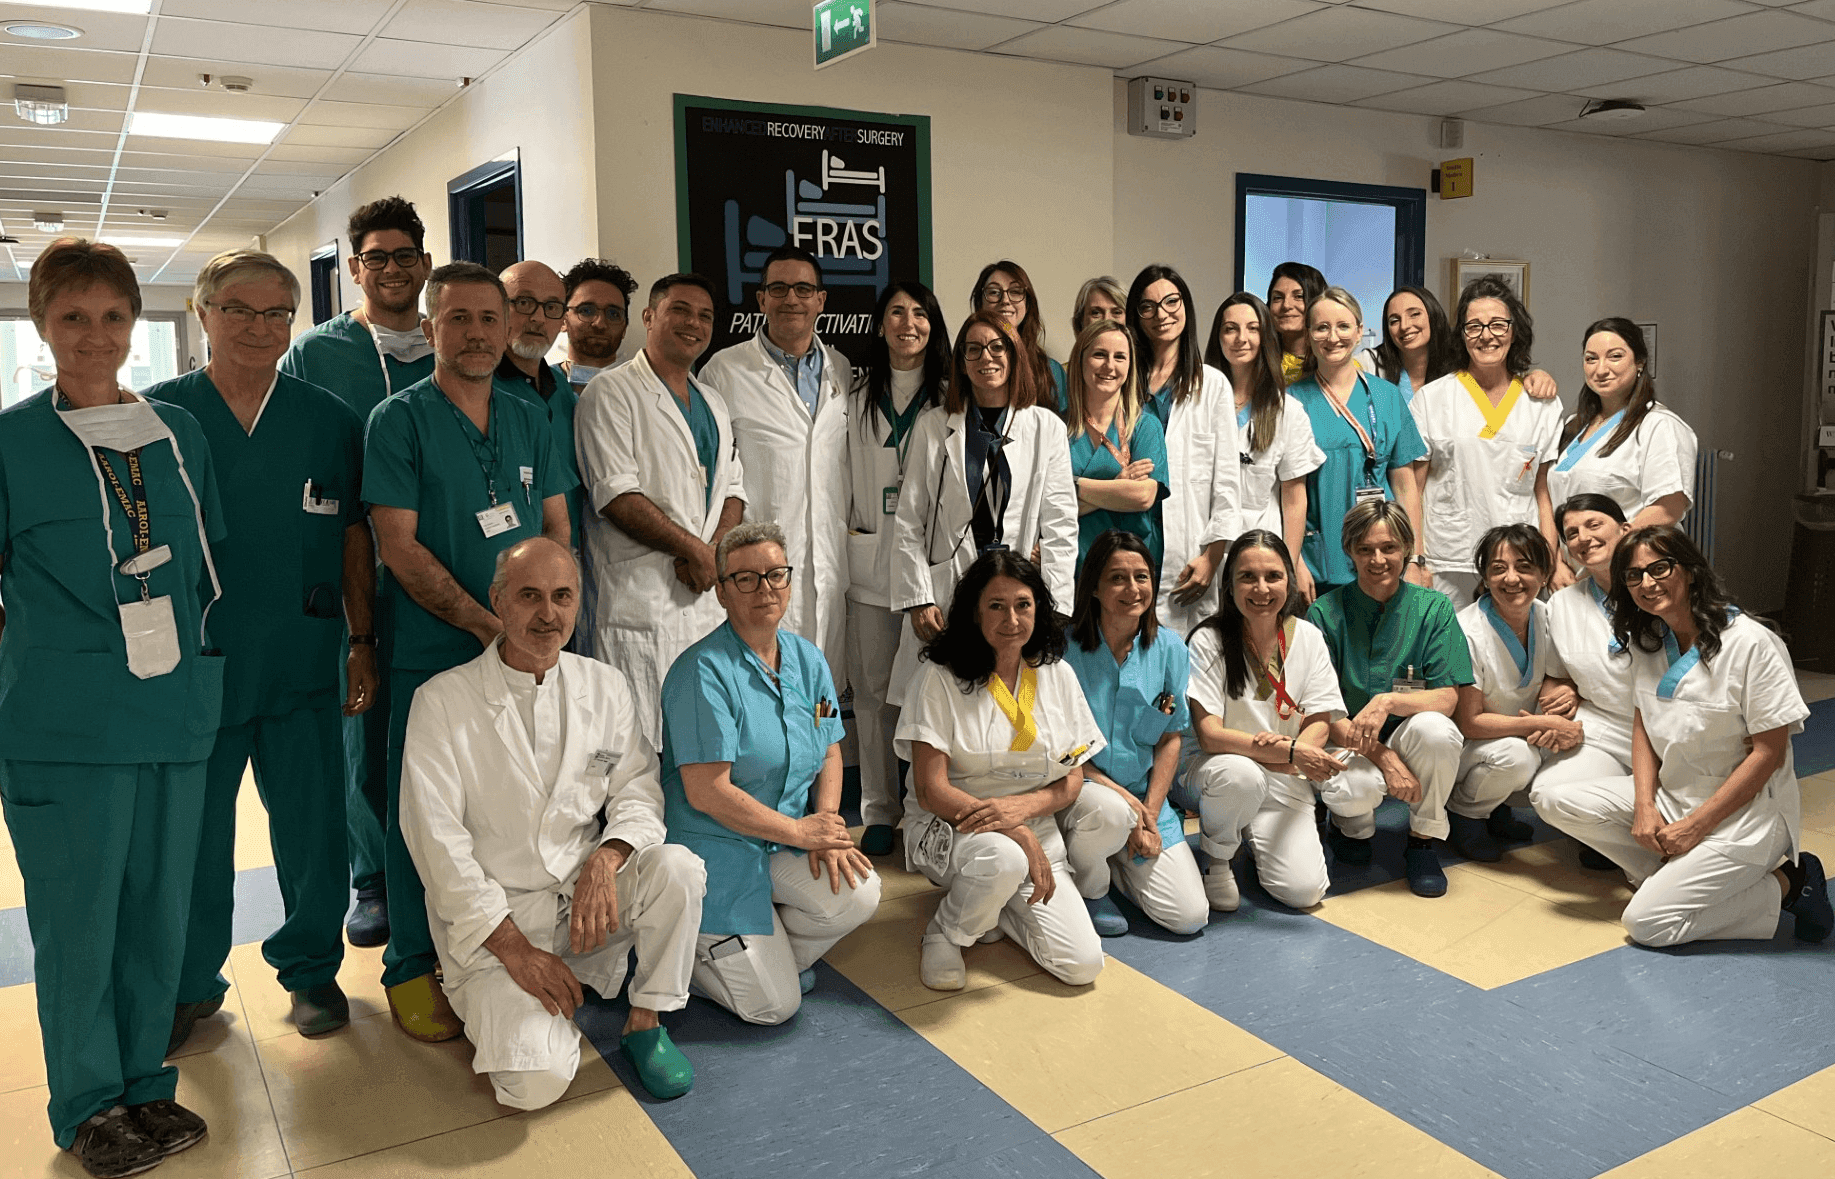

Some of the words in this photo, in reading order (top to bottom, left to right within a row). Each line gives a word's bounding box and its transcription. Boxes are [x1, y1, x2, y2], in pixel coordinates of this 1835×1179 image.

[702, 116, 767, 136] ENHANCED
[767, 121, 825, 140] RECOVERY
[824, 126, 857, 143] AFTER
[857, 129, 904, 147] SURGERY
[793, 216, 883, 260] ERAS
[729, 312, 767, 334] PATI
[814, 313, 875, 334] CTIVATI
